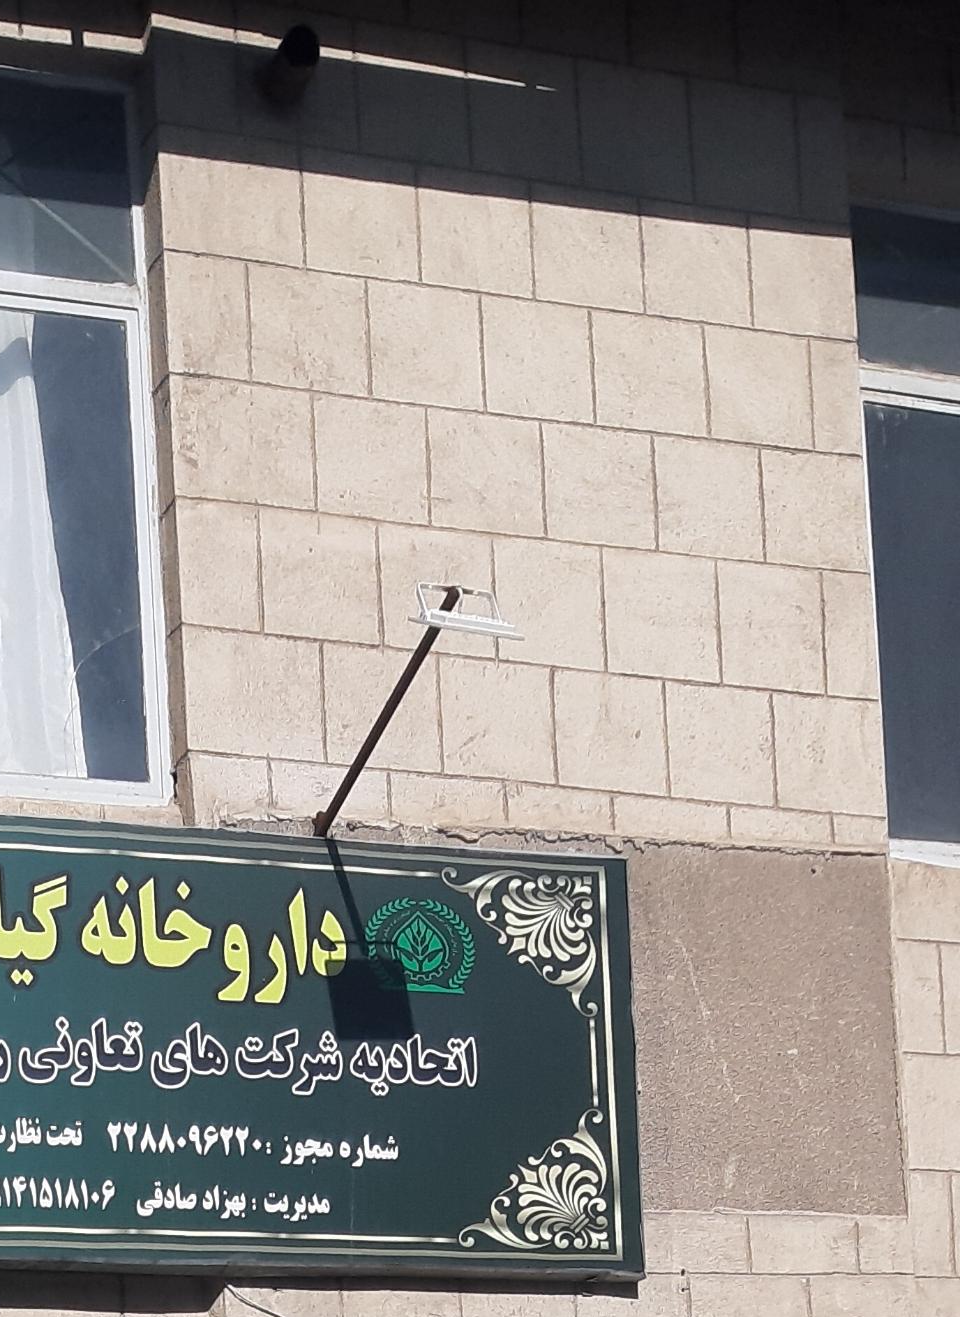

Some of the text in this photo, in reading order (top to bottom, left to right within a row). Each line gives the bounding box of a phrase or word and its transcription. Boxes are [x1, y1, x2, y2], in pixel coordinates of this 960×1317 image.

[81, 875, 348, 1004] داروخانه
[19, 1015, 144, 1087] تعاونی
[150, 1020, 229, 1089] های
[235, 1027, 343, 1096] شرکت
[349, 1032, 478, 1097] اتحادیه
[46, 1118, 83, 1147] تحت
[279, 1134, 334, 1165] مجوز
[338, 1132, 399, 1167] شماره
[136, 1179, 198, 1217] صادقی
[202, 1183, 247, 1220] بهزاد
[263, 1191, 331, 1222] مدیریت
